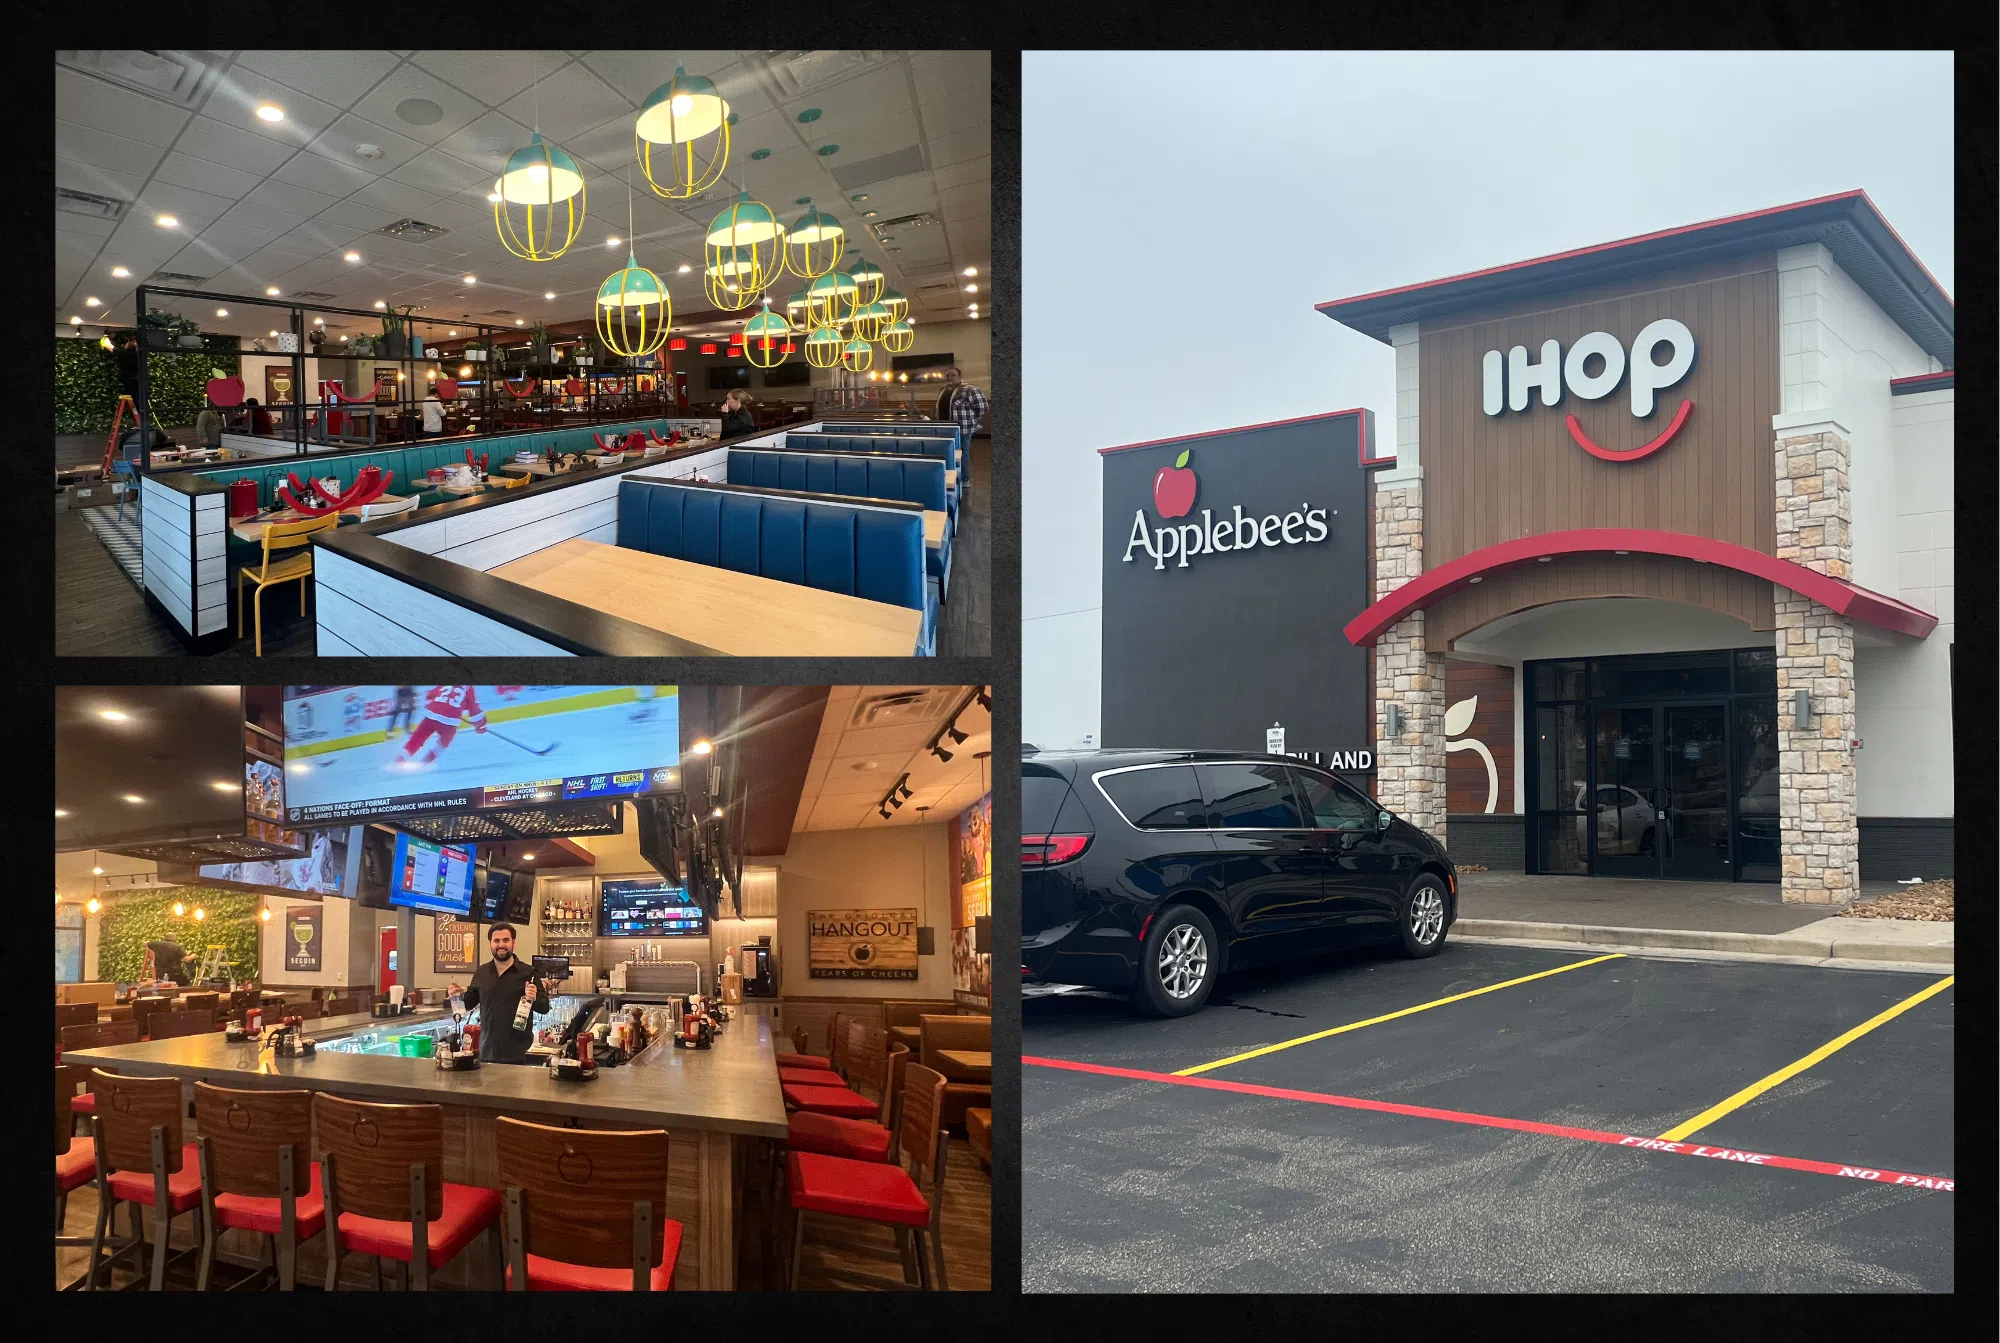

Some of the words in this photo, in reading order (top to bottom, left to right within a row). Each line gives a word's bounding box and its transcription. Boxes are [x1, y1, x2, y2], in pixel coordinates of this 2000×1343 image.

[1483, 319, 1695, 417] IHOP
[1122, 503, 1328, 570] Applebee's
[435, 686, 466, 707] 23
[1330, 750, 1372, 770] AND
[567, 779, 585, 787] NHL
[590, 776, 606, 784] FIRST
[615, 774, 641, 782] RETURNS
[494, 794, 521, 802] CLEVELAND
[309, 805, 333, 813] NATIONS
[334, 801, 364, 811] FACE-OFF:
[365, 799, 391, 808] FORMAT
[314, 812, 332, 820] GAMES
[378, 803, 416, 813] ACCORDANCE
[418, 801, 433, 809] WITH
[447, 798, 467, 806] RULES
[845, 912, 916, 920] ORIGINAL
[812, 922, 914, 937] HANGOUT
[438, 933, 462, 952] GOOD
[290, 957, 316, 965] SEGUIN
[1619, 1136, 1685, 1152] FIRE
[1692, 1147, 1773, 1165] LANE
[1837, 1167, 1881, 1180] NO
[1896, 1175, 1954, 1192] PAR
